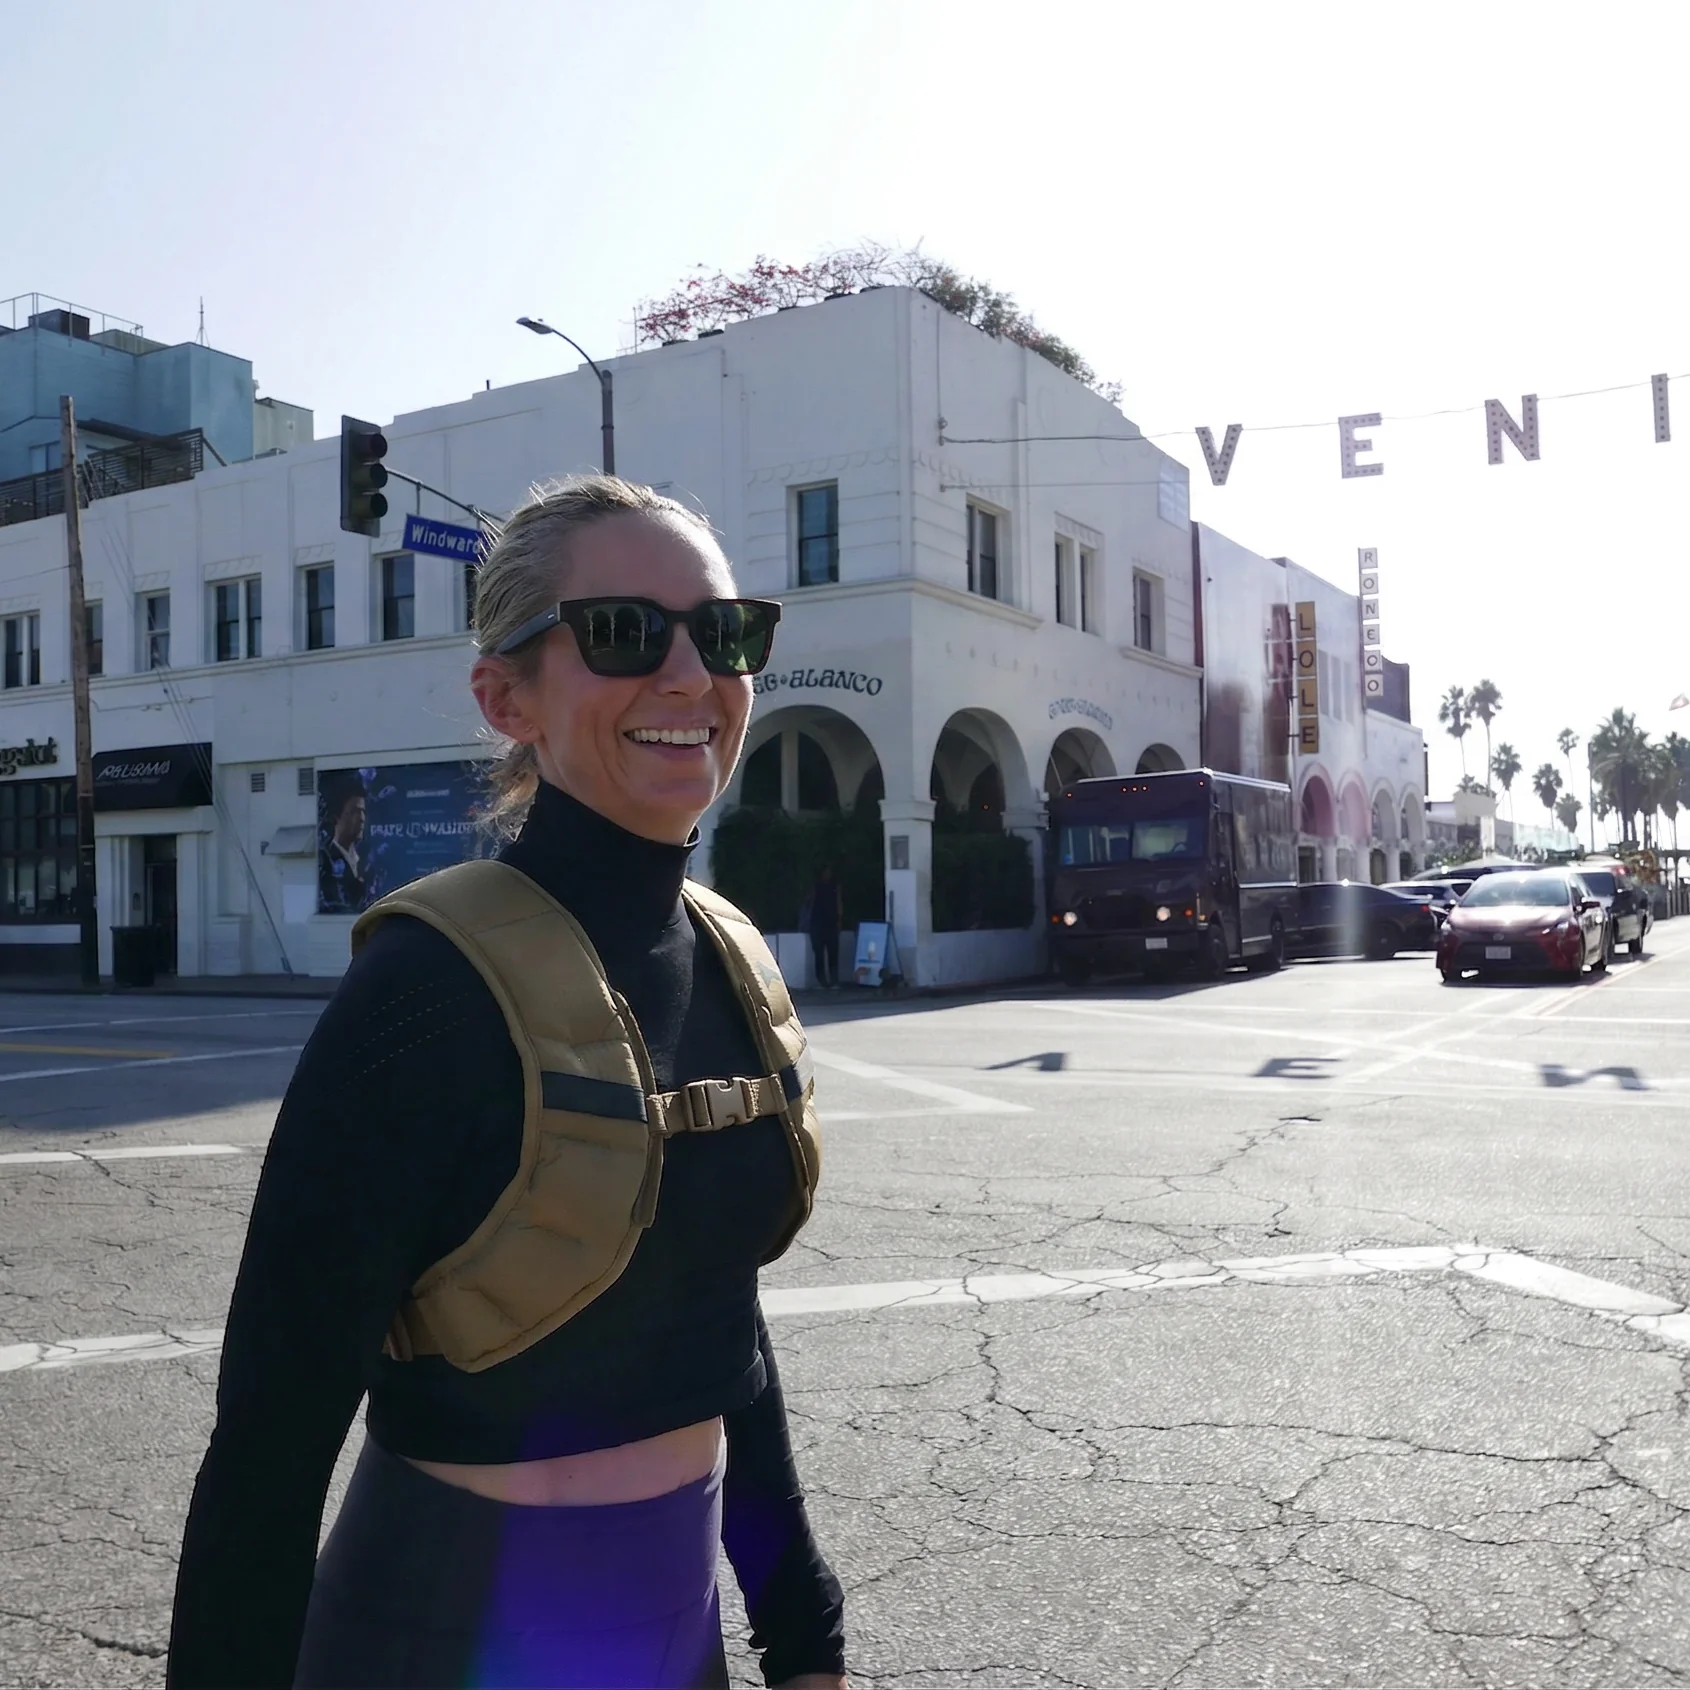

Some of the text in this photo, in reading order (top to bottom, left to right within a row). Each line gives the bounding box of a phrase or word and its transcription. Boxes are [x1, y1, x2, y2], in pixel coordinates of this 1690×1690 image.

[1195, 373, 1671, 486] VENI
[411, 523, 482, 555] Windward
[1299, 612, 1316, 744] LOLE
